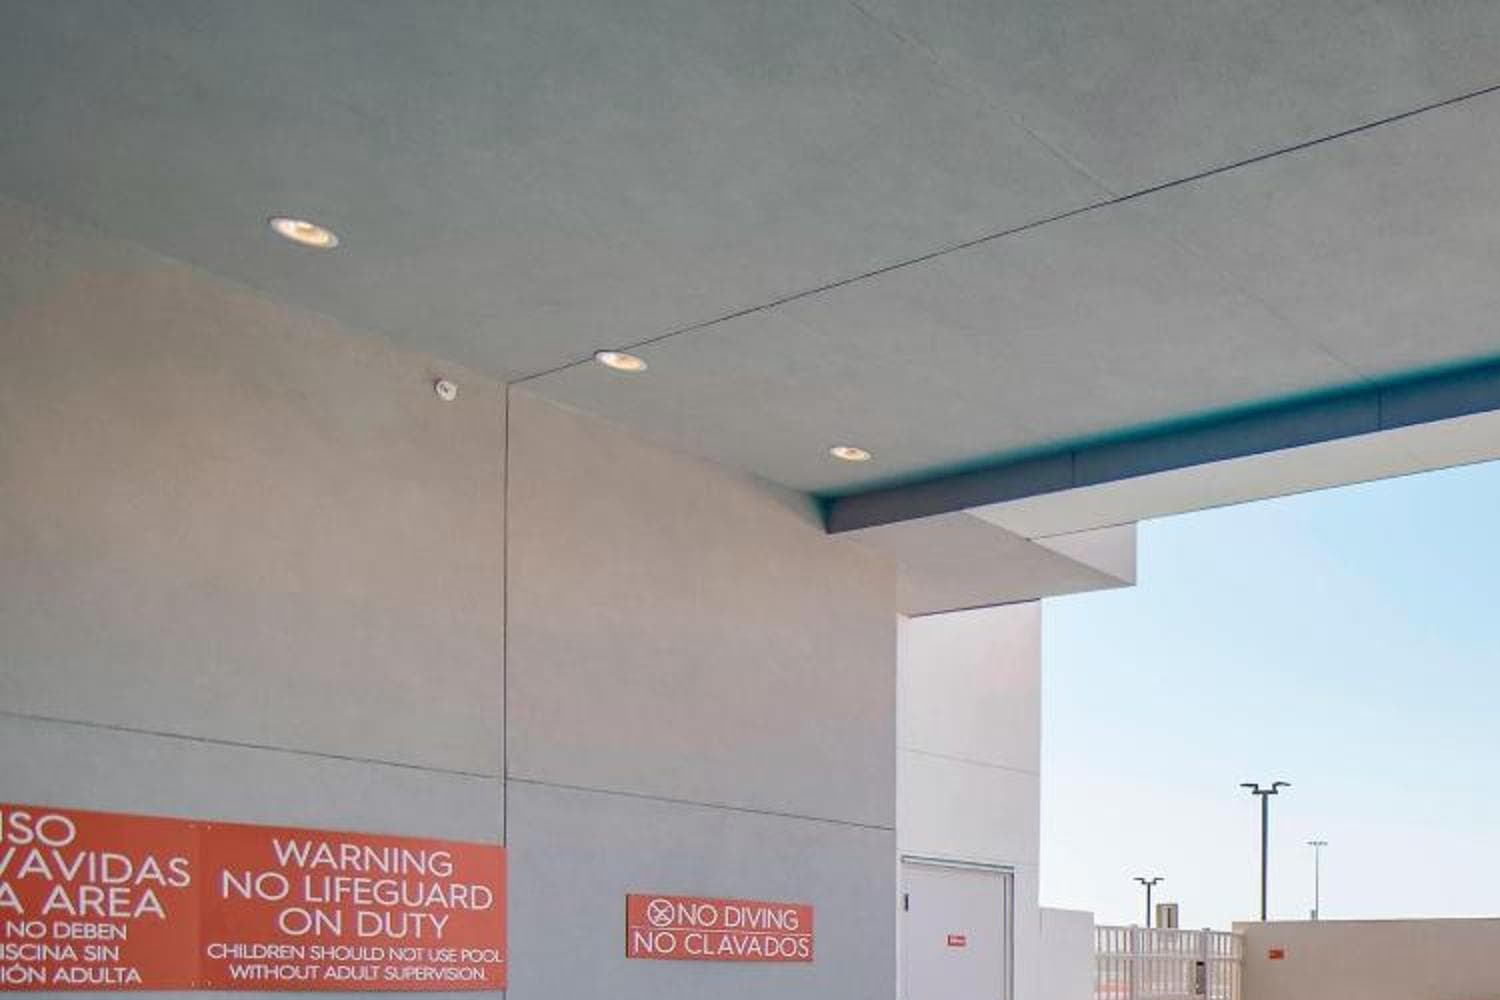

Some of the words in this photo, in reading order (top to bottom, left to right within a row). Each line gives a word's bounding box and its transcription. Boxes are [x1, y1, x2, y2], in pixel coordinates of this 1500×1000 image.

[273, 838, 453, 877] WARNING
[42, 884, 166, 919] AREA
[222, 869, 289, 901] NO
[305, 875, 494, 910] LIFEGUARD
[6, 921, 47, 939] NO
[53, 922, 127, 940] DEBEN
[279, 907, 341, 936] ON
[356, 910, 449, 939] DUTY
[677, 903, 718, 927] NO
[724, 905, 799, 931] DIVING
[84, 945, 119, 961] SIN
[207, 943, 305, 959] CHILDREN
[309, 945, 385, 961] SHOULD
[389, 946, 424, 961] NOT
[429, 948, 457, 962] USE
[461, 949, 505, 963] POOL
[634, 931, 676, 953] NO
[685, 932, 810, 958] CLAVADOS
[53, 967, 142, 984] ADULTA
[229, 963, 320, 980] WITHOUT
[323, 965, 379, 981] ADULT
